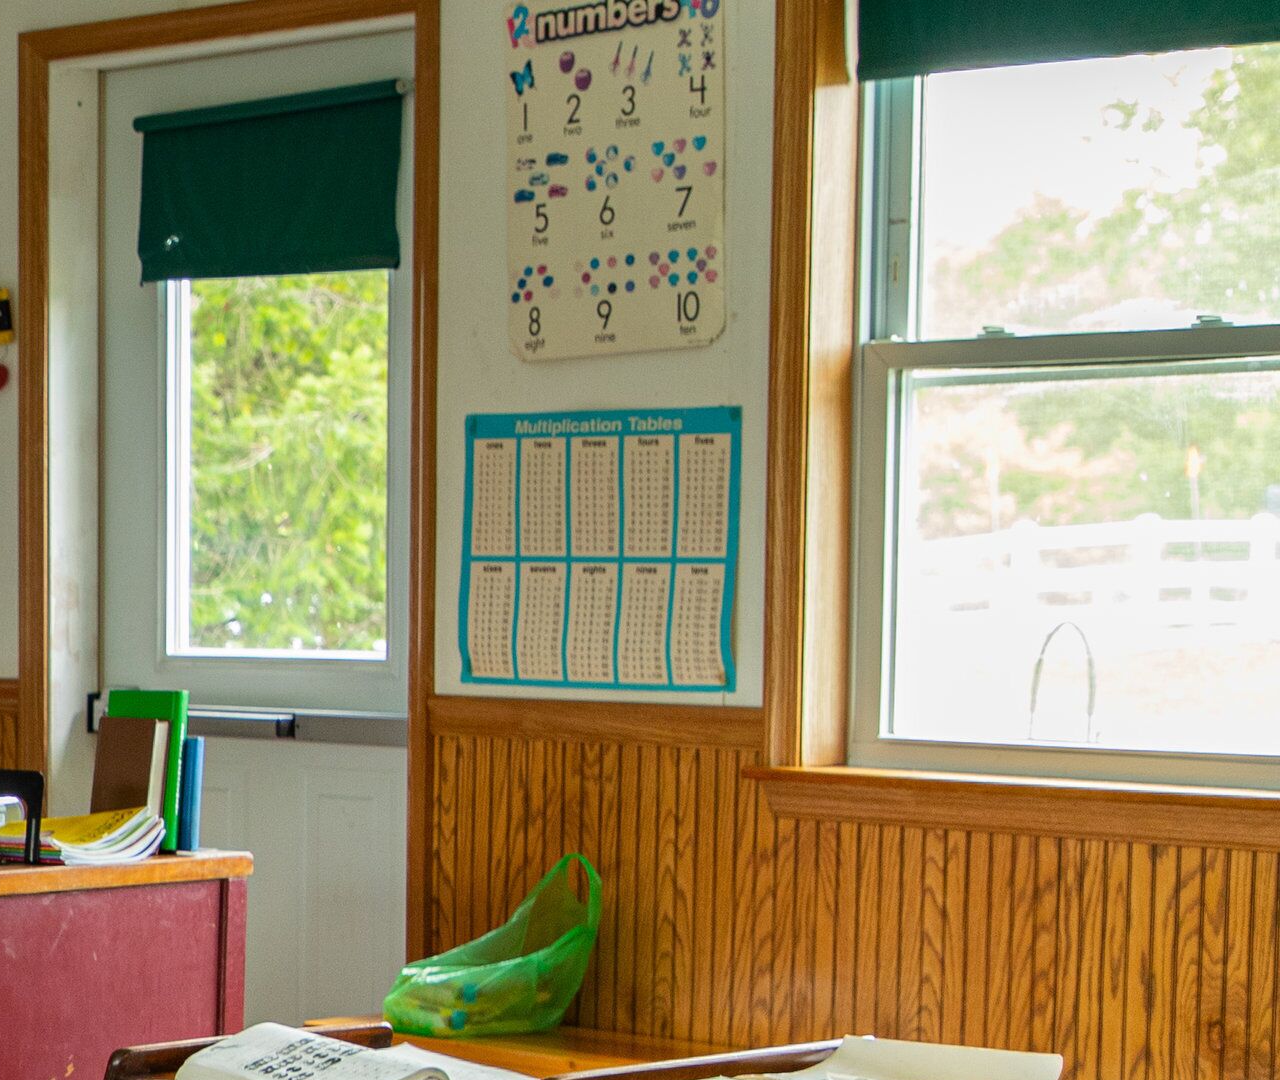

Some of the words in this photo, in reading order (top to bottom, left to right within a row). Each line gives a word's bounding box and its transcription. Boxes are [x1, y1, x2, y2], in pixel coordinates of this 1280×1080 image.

[536, 0, 681, 43] numbers
[522, 103, 528, 131] 1
[566, 94, 581, 125] 2
[620, 85, 637, 116] 3
[689, 75, 708, 104] 4
[534, 203, 549, 233] 5
[599, 196, 615, 225] 6
[675, 186, 693, 217] 7
[528, 307, 541, 336] 8
[596, 300, 612, 330] 9
[676, 291, 700, 323] 10
[515, 417, 622, 437] Multiplication
[629, 416, 683, 432] Tables
